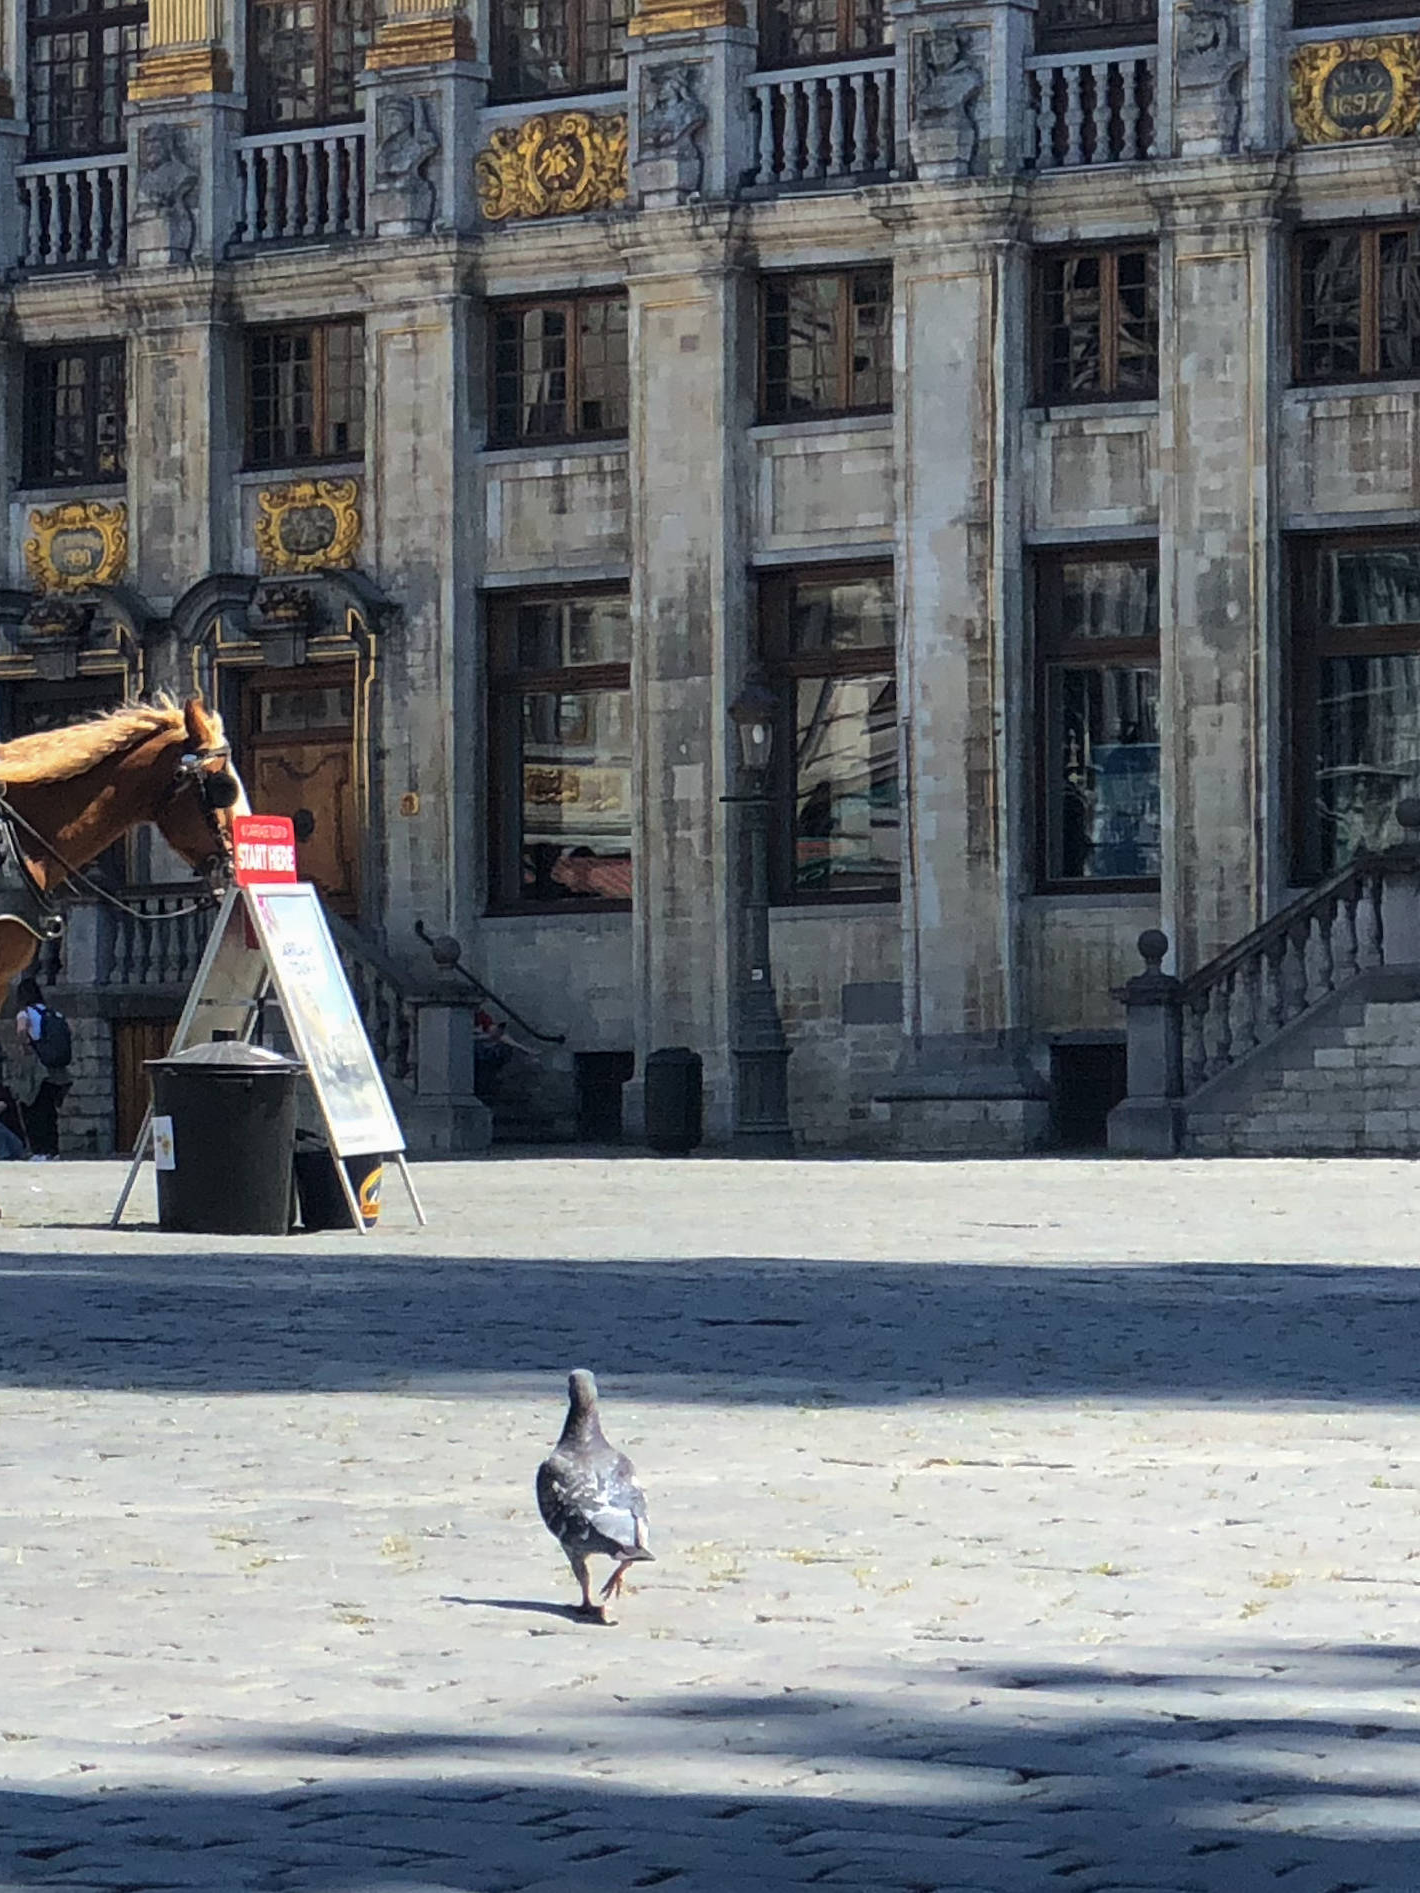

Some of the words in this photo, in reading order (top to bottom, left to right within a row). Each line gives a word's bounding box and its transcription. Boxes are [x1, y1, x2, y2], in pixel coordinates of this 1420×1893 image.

[1331, 90, 1386, 115] 1697
[237, 843, 267, 871] START
[268, 844, 296, 872] HERE
